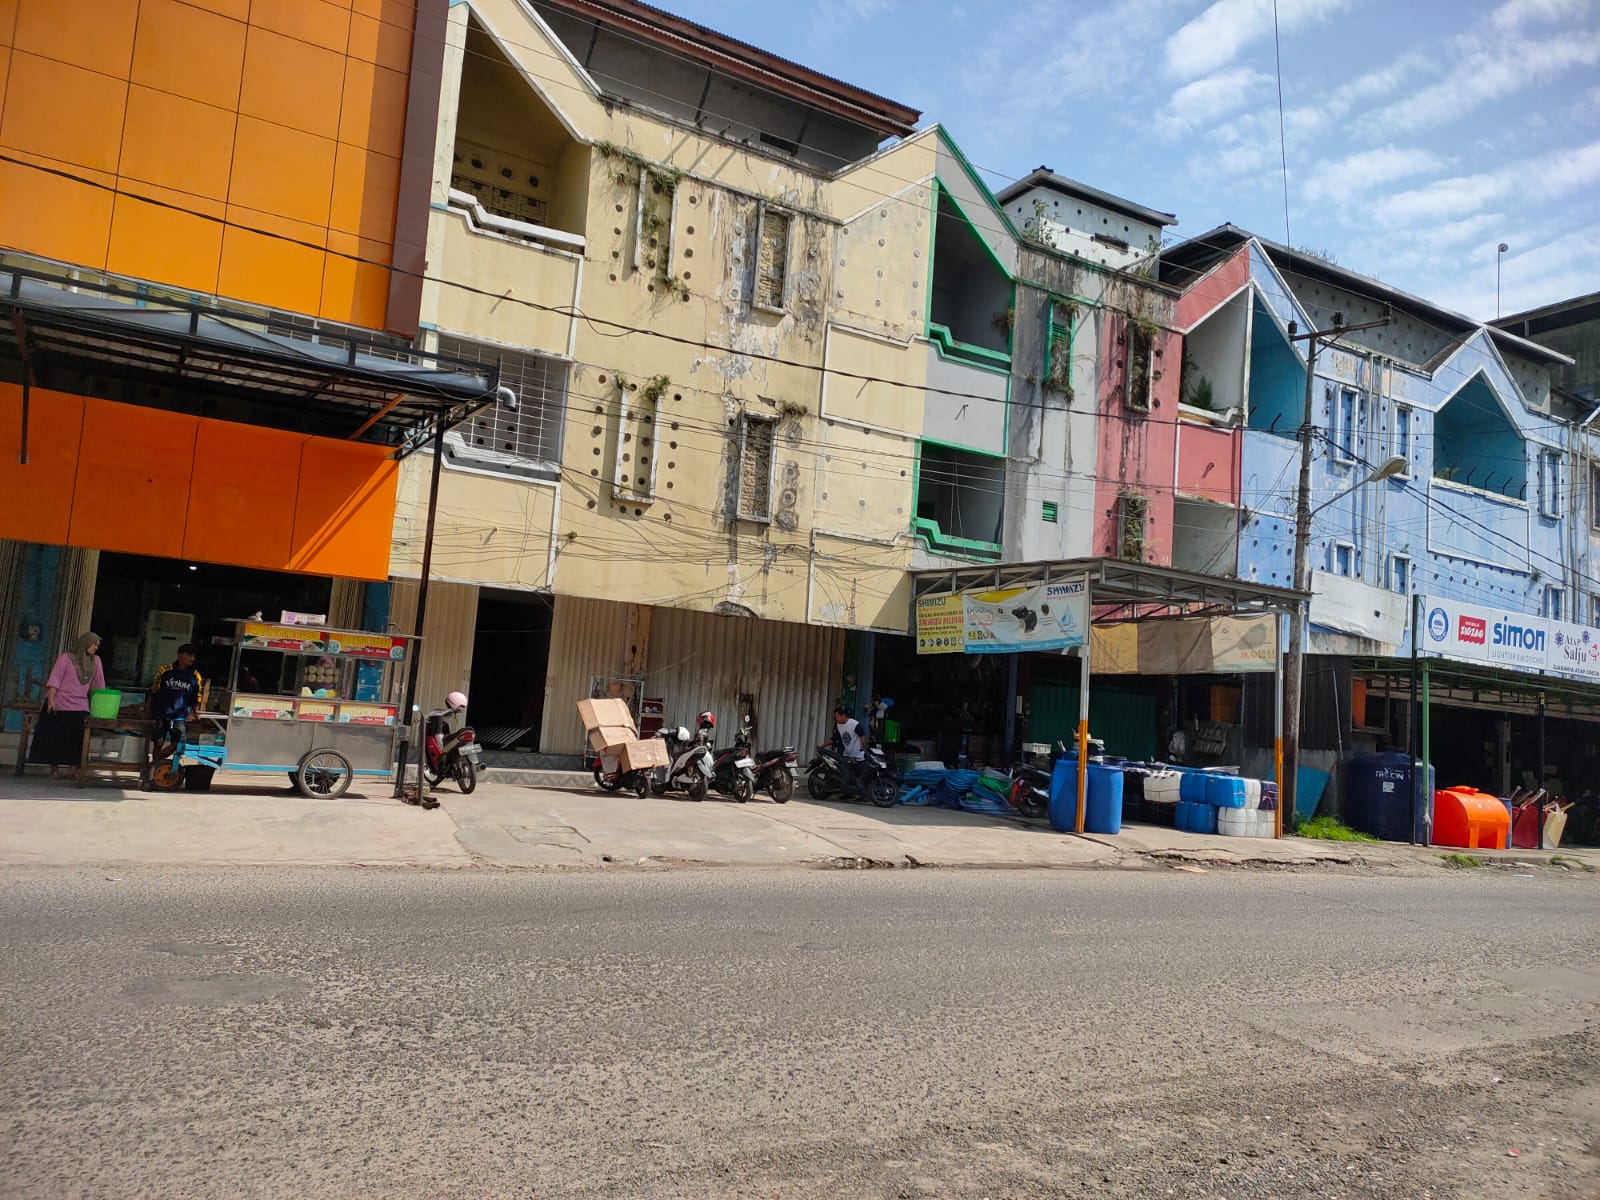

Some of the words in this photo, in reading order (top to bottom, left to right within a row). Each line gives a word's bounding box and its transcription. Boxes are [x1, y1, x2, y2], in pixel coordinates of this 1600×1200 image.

[1046, 582, 1085, 596] SHIMIZU
[918, 597, 946, 608] SHIMIZU
[1493, 615, 1545, 652] simon
[1563, 645, 1587, 665] Salju
[165, 677, 191, 691] VENOM
